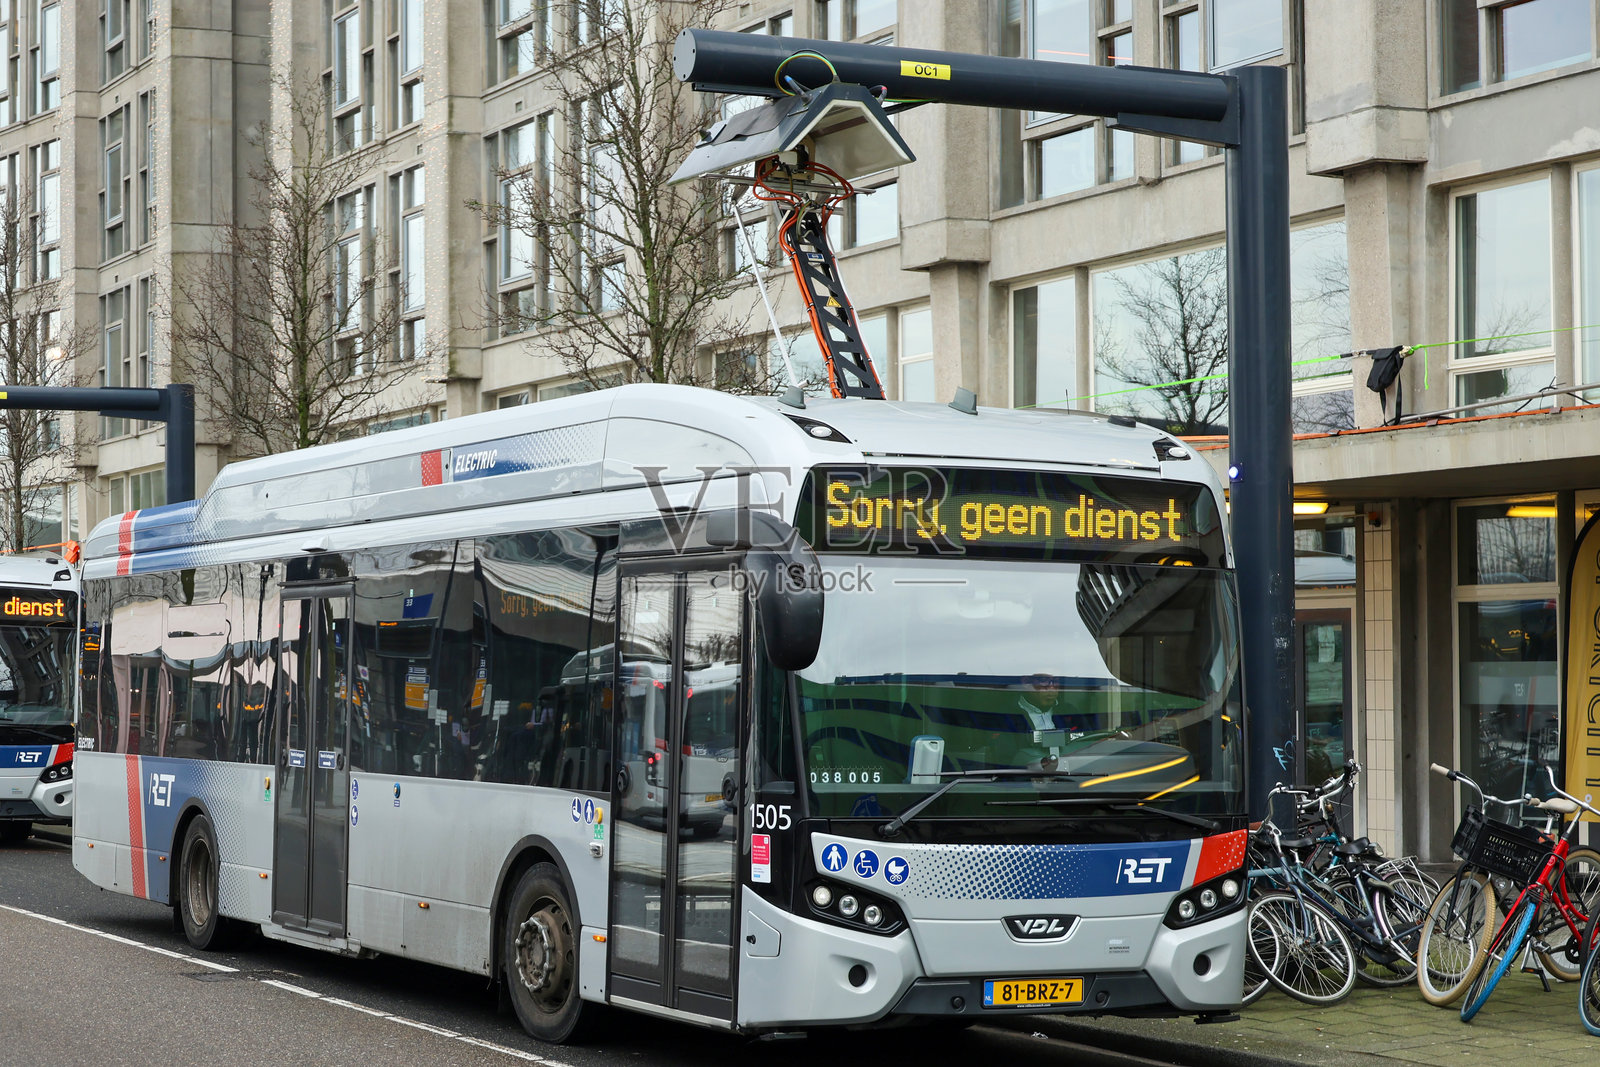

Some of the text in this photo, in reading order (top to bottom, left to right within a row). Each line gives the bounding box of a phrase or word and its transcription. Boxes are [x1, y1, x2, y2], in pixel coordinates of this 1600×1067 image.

[914, 64, 938, 77] OC1
[455, 449, 498, 474] ELECTRIC
[826, 481, 1182, 542] Sorry, geen dienst
[3, 596, 65, 617] dienst
[15, 751, 42, 762] RET
[148, 772, 176, 807] RET
[749, 803, 792, 830] 1505
[1116, 858, 1173, 884] RET
[1014, 918, 1064, 934] VDL
[1002, 982, 1074, 1002] 81-BRZ-7
